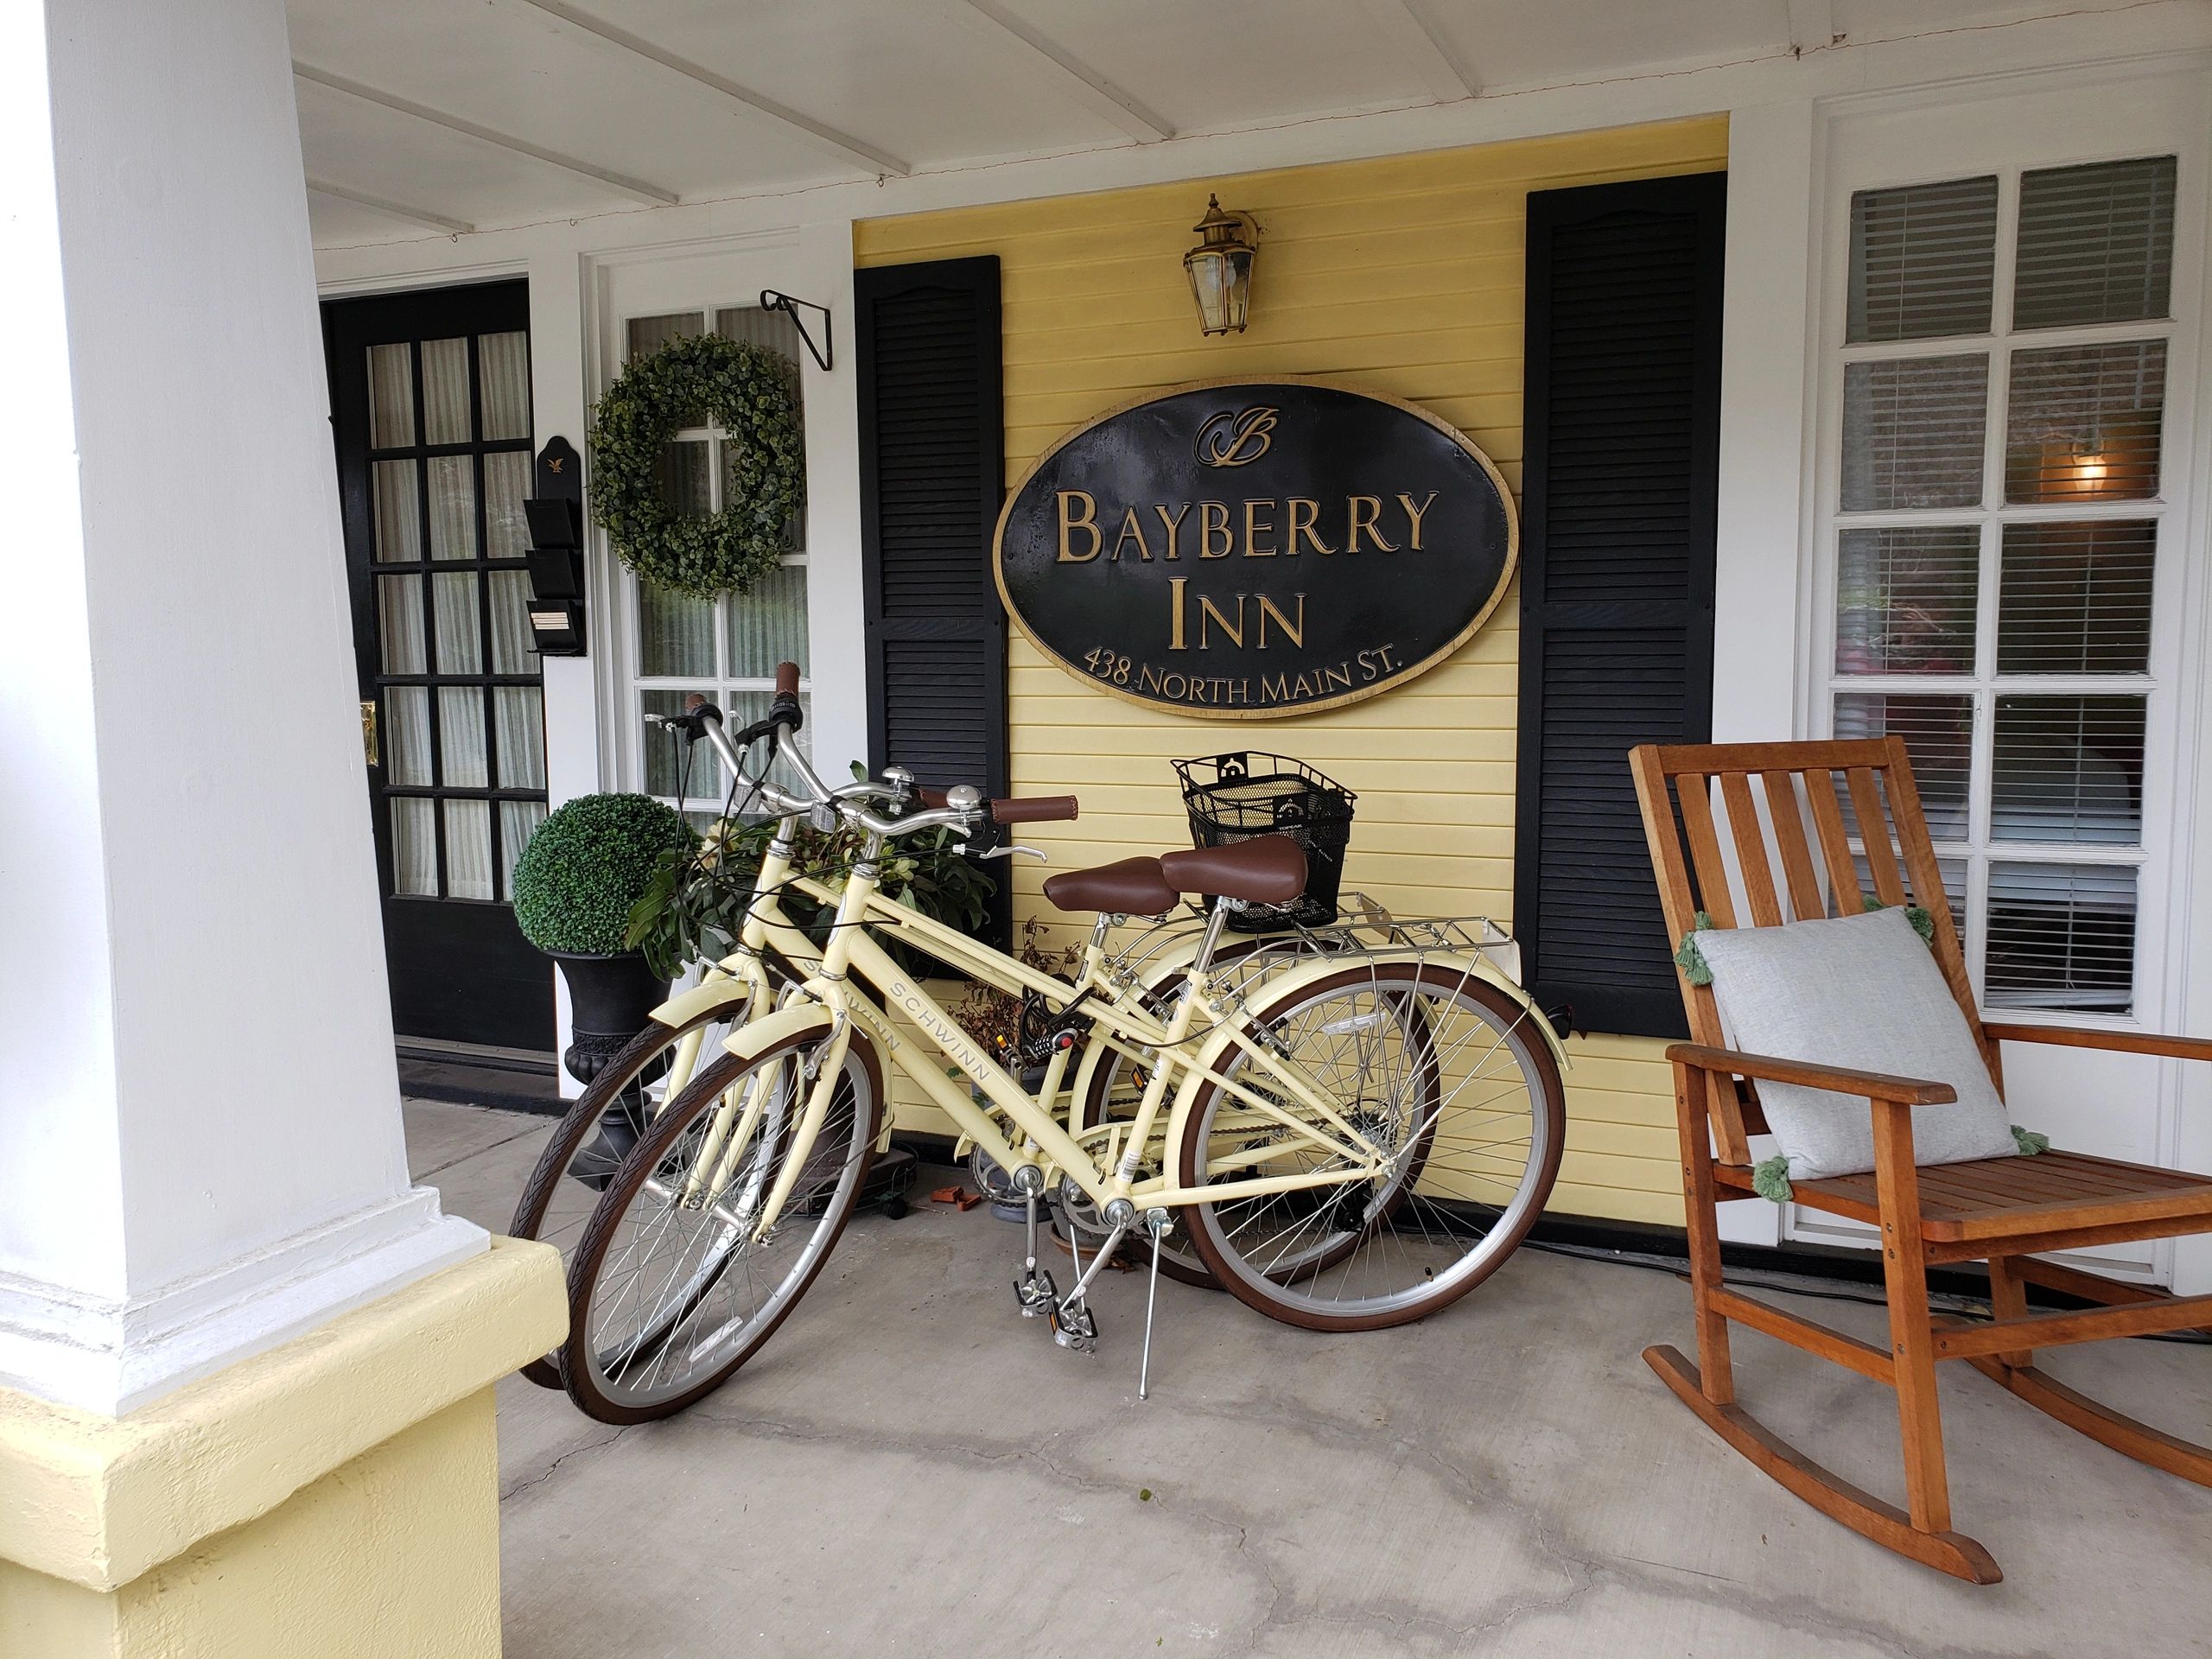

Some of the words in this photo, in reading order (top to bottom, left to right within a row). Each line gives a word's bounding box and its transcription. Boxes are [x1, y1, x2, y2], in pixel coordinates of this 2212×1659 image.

[1055, 489, 1440, 562] BAYBERRY
[1167, 576, 1306, 650] INN
[1084, 647, 1131, 685] 438
[1139, 664, 1249, 703] NORTH
[1259, 660, 1352, 703] MAIN
[1357, 643, 1404, 682] ST.
[890, 982, 990, 1081] SCHWINN
